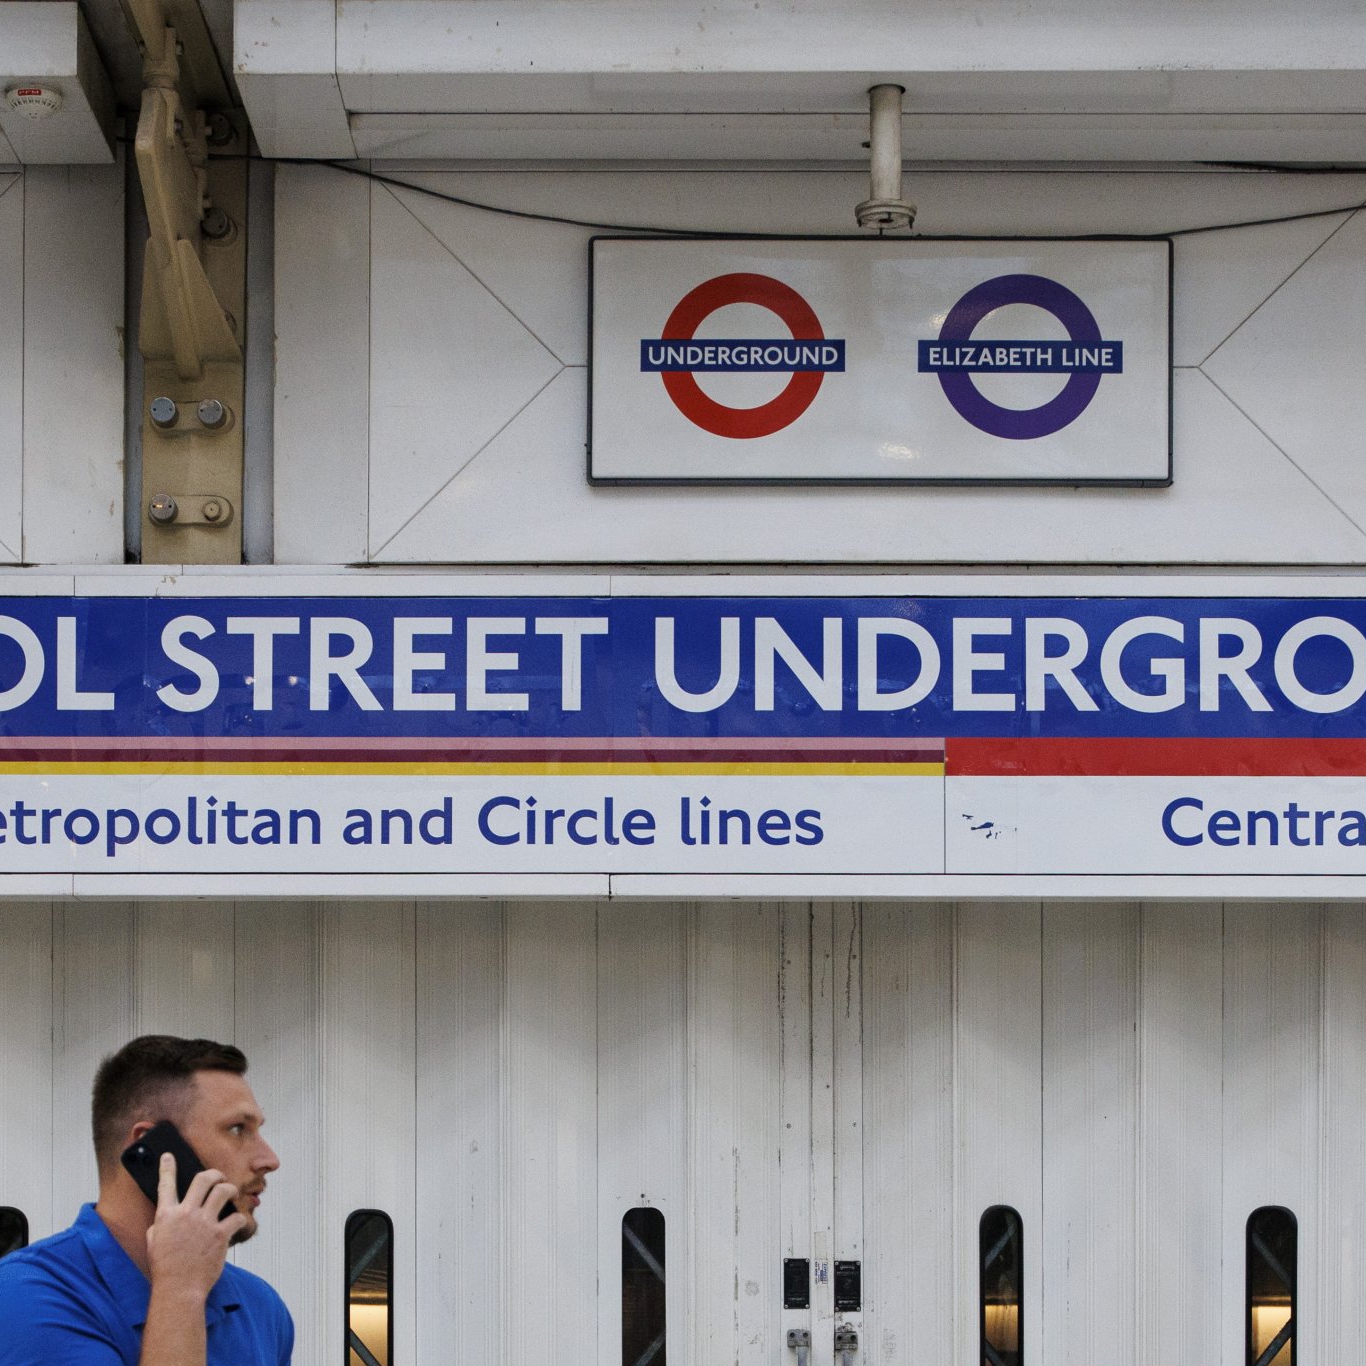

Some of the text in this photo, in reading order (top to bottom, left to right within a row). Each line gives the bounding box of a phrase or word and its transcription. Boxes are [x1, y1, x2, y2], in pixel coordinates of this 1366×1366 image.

[649, 347, 837, 364] UNDERGROUND
[930, 348, 1113, 366] ELIZABETH LINE
[156, 616, 608, 712] STREET
[343, 797, 452, 845] and
[478, 796, 655, 845] Circle
[681, 796, 823, 845] lines
